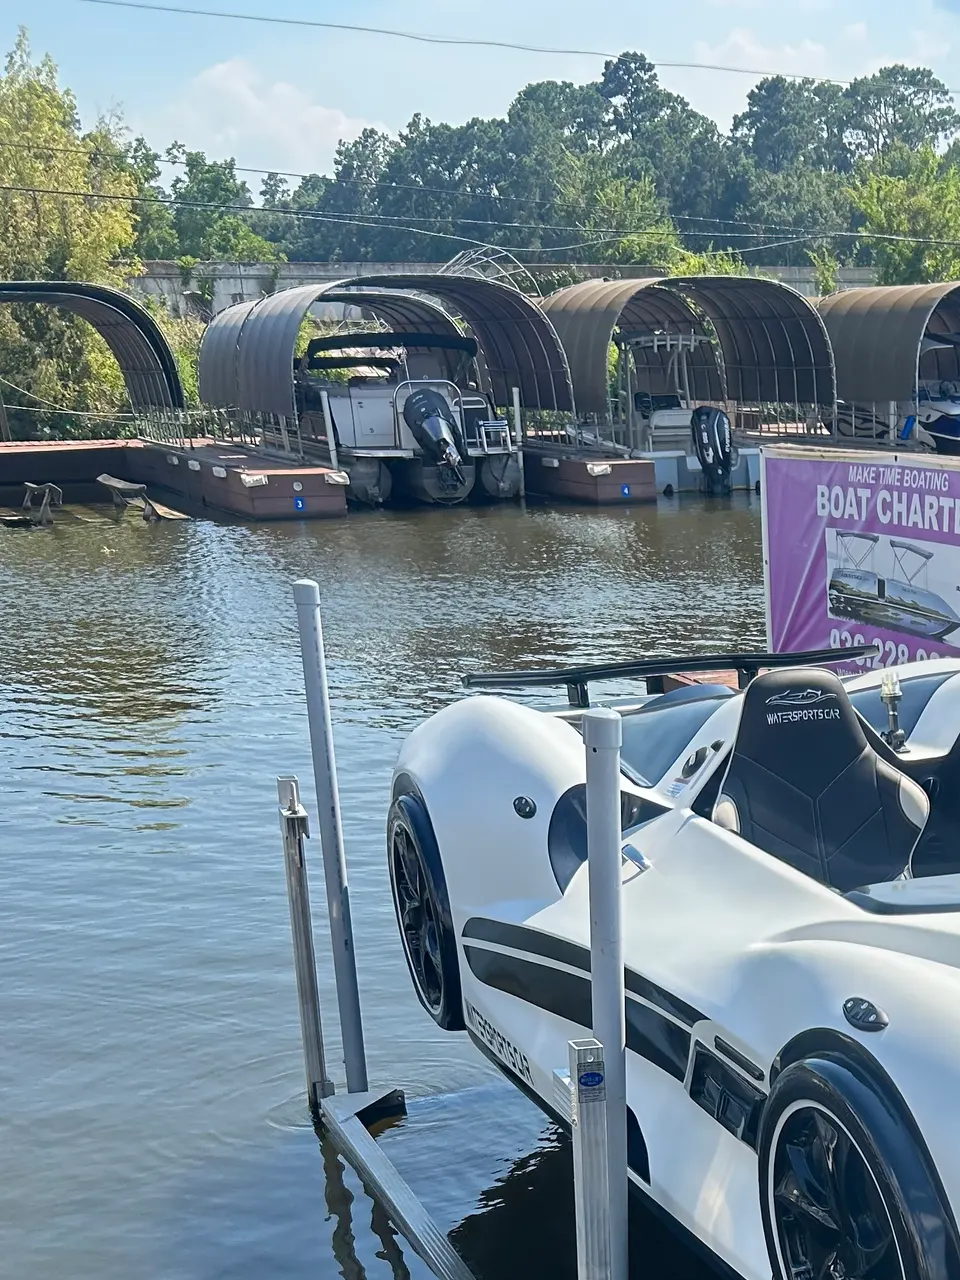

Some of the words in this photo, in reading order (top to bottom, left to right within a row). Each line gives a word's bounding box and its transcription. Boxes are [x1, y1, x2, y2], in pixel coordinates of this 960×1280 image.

[848, 465, 876, 484] MAKE
[879, 467, 901, 486] TIME
[903, 470, 949, 491] BOATING
[816, 484, 871, 522] BOAT
